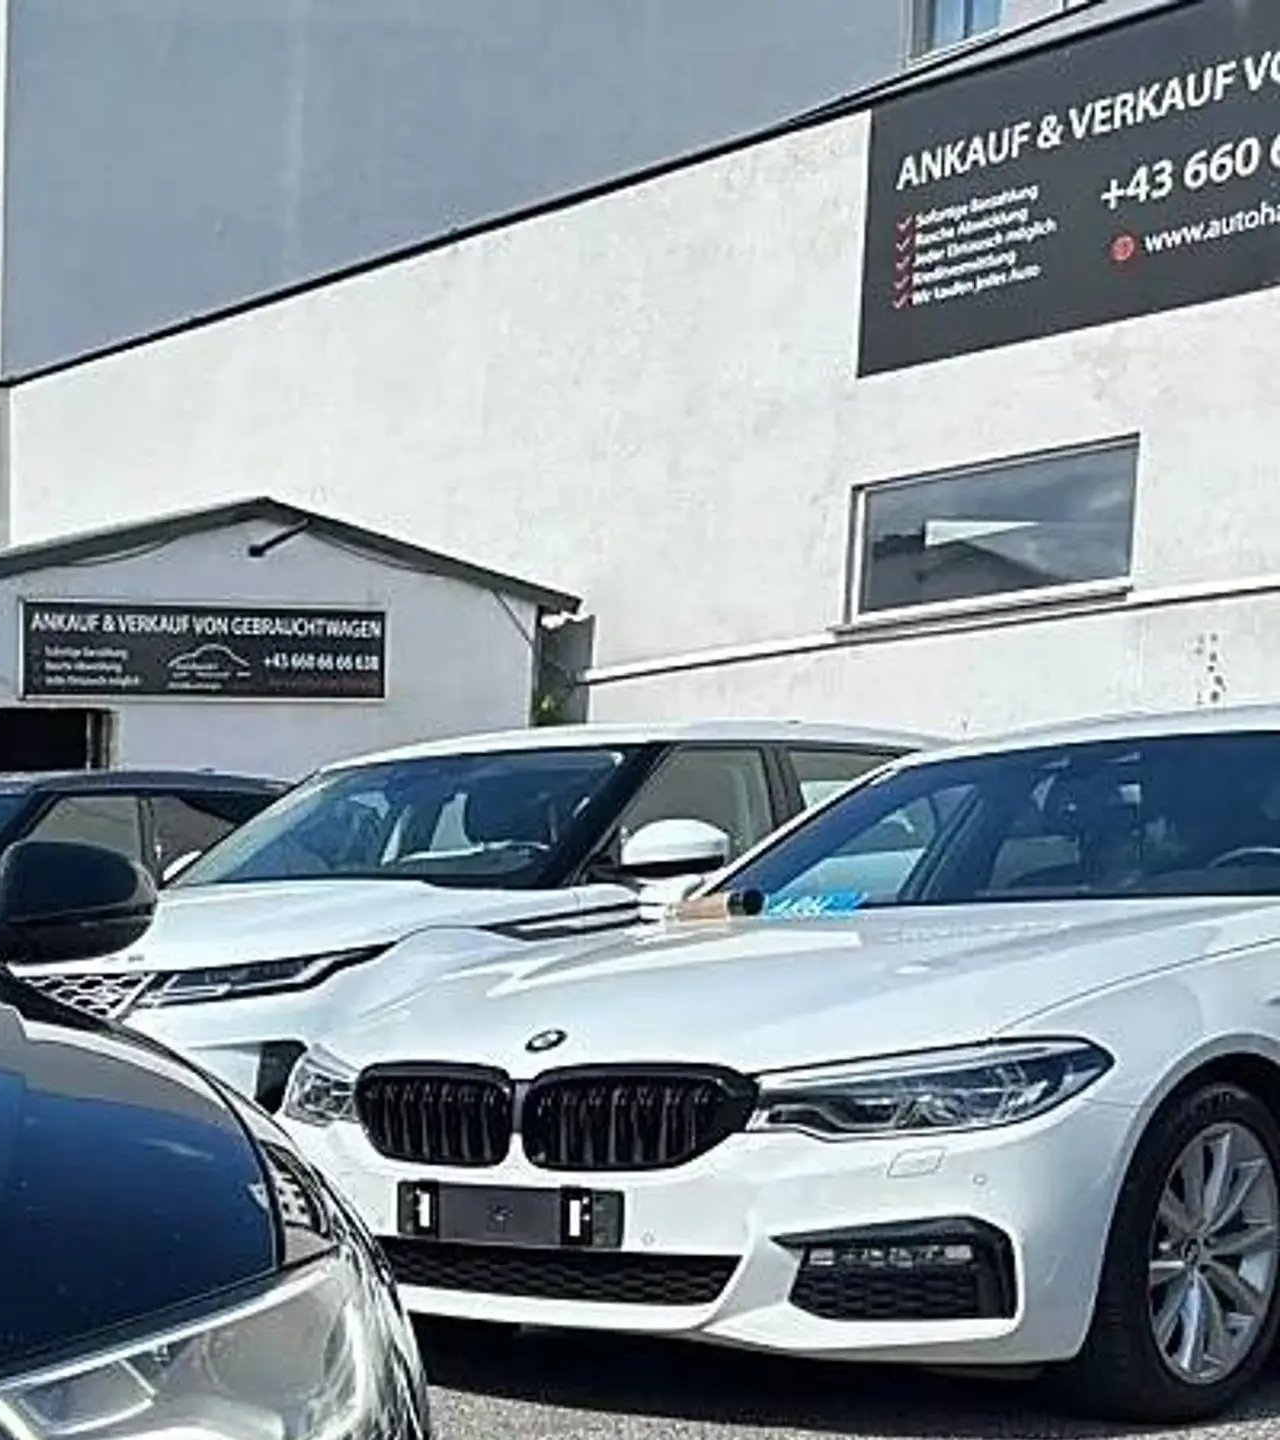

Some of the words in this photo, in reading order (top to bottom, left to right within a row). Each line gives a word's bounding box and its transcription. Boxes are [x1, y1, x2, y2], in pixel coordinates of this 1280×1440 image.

[896, 122, 1032, 190] ANKAUF
[1037, 114, 1063, 149] &
[1068, 61, 1238, 141] VERKAUF
[1100, 159, 1174, 210] +43
[1183, 136, 1262, 189] 660
[31, 612, 101, 632] ANKAUF
[102, 613, 116, 633] &
[117, 613, 190, 634] VERKAUF
[192, 615, 229, 636] VON
[230, 616, 382, 639] GEBRAUCHTWAGEN
